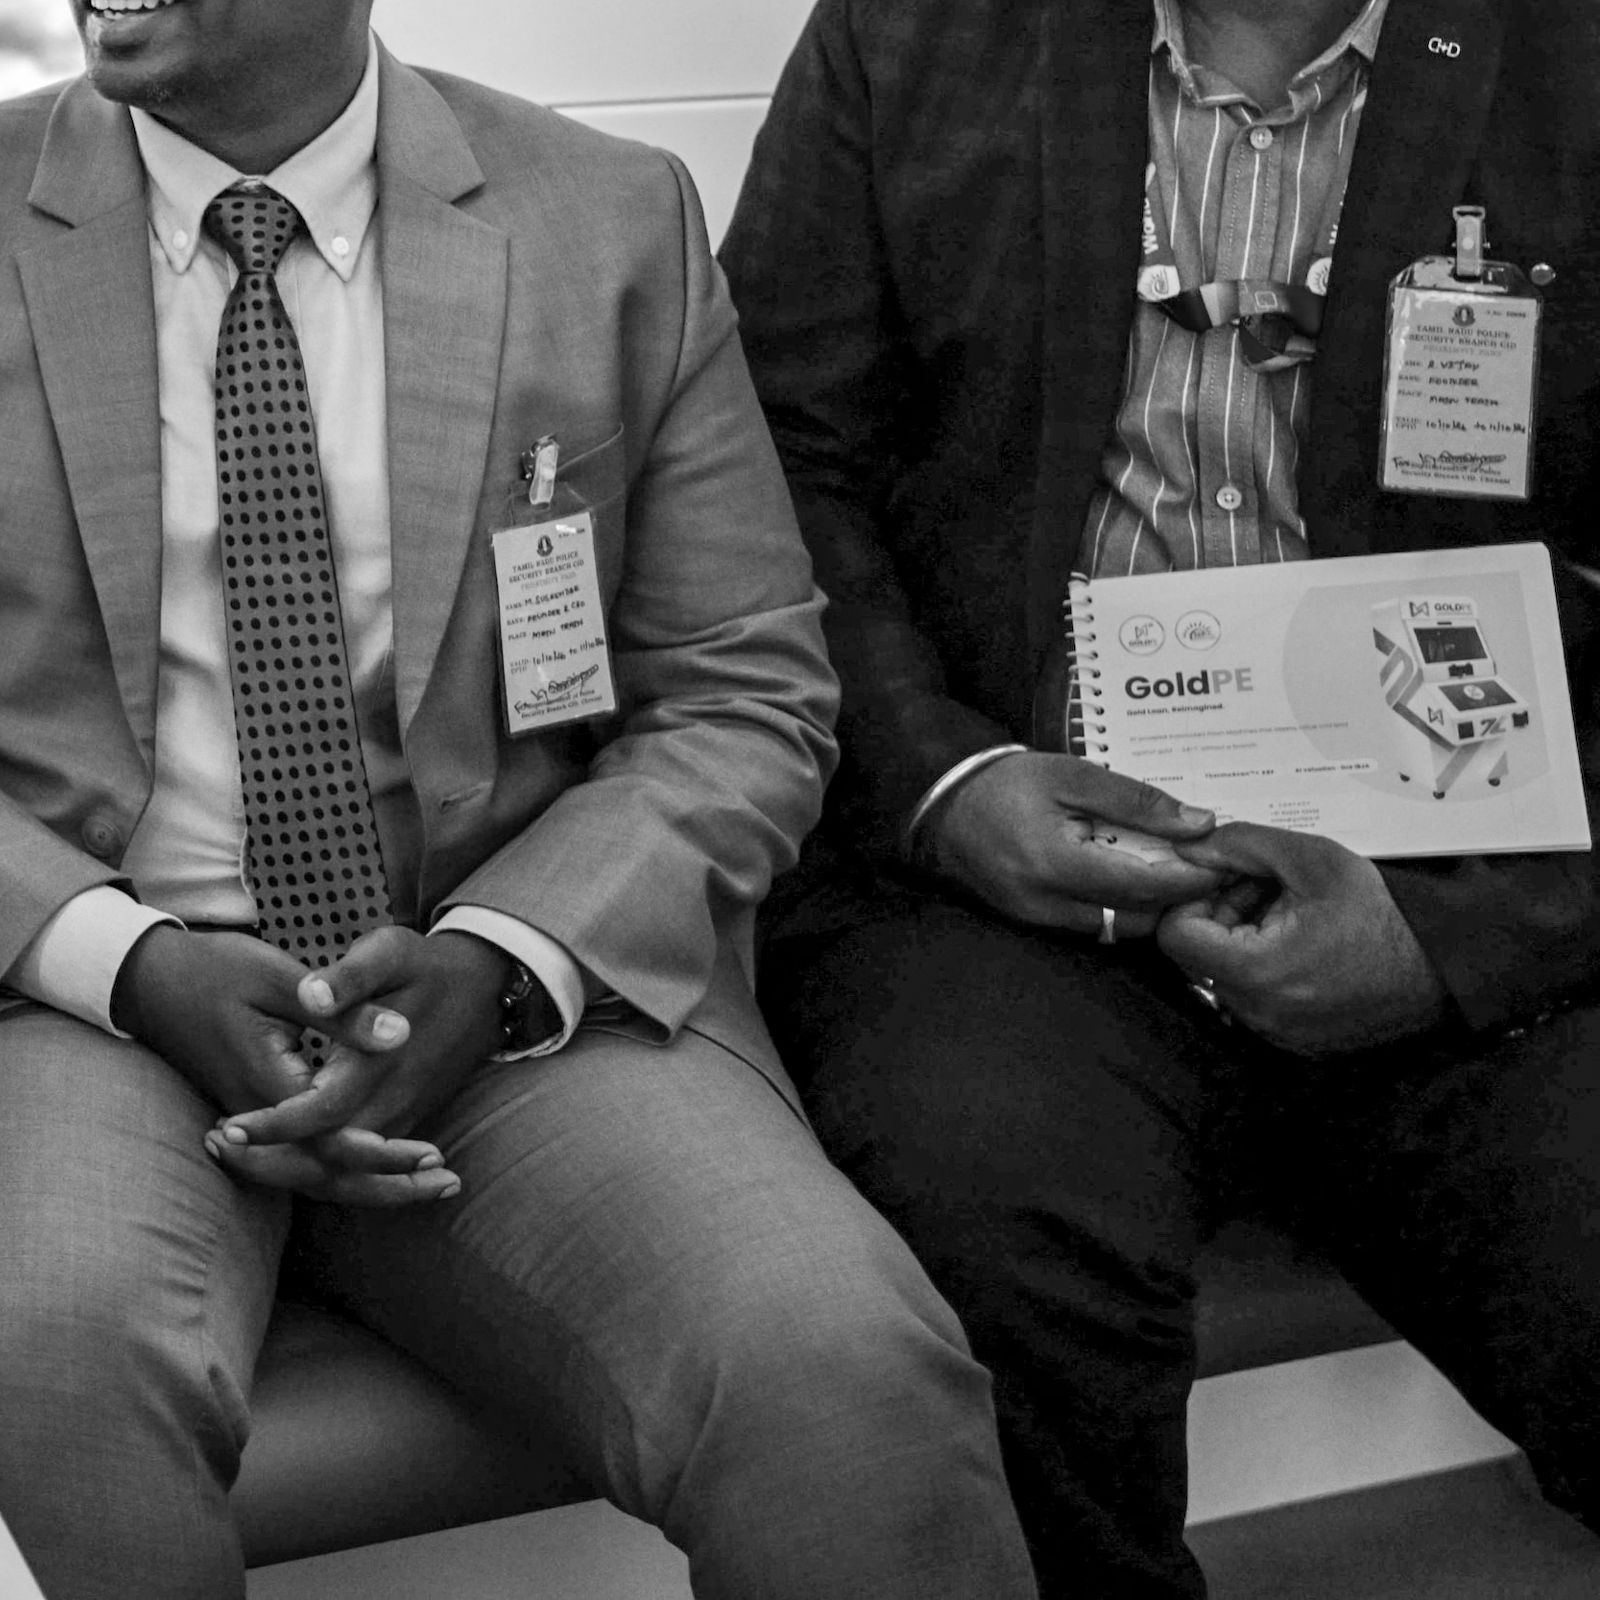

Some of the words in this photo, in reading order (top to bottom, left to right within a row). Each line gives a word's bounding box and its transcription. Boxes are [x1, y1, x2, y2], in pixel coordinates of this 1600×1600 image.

[512, 562, 534, 573] TAMIL
[556, 551, 579, 562] POLICE
[509, 570, 543, 583] SECURITY
[1124, 667, 1254, 699] GoldPE
